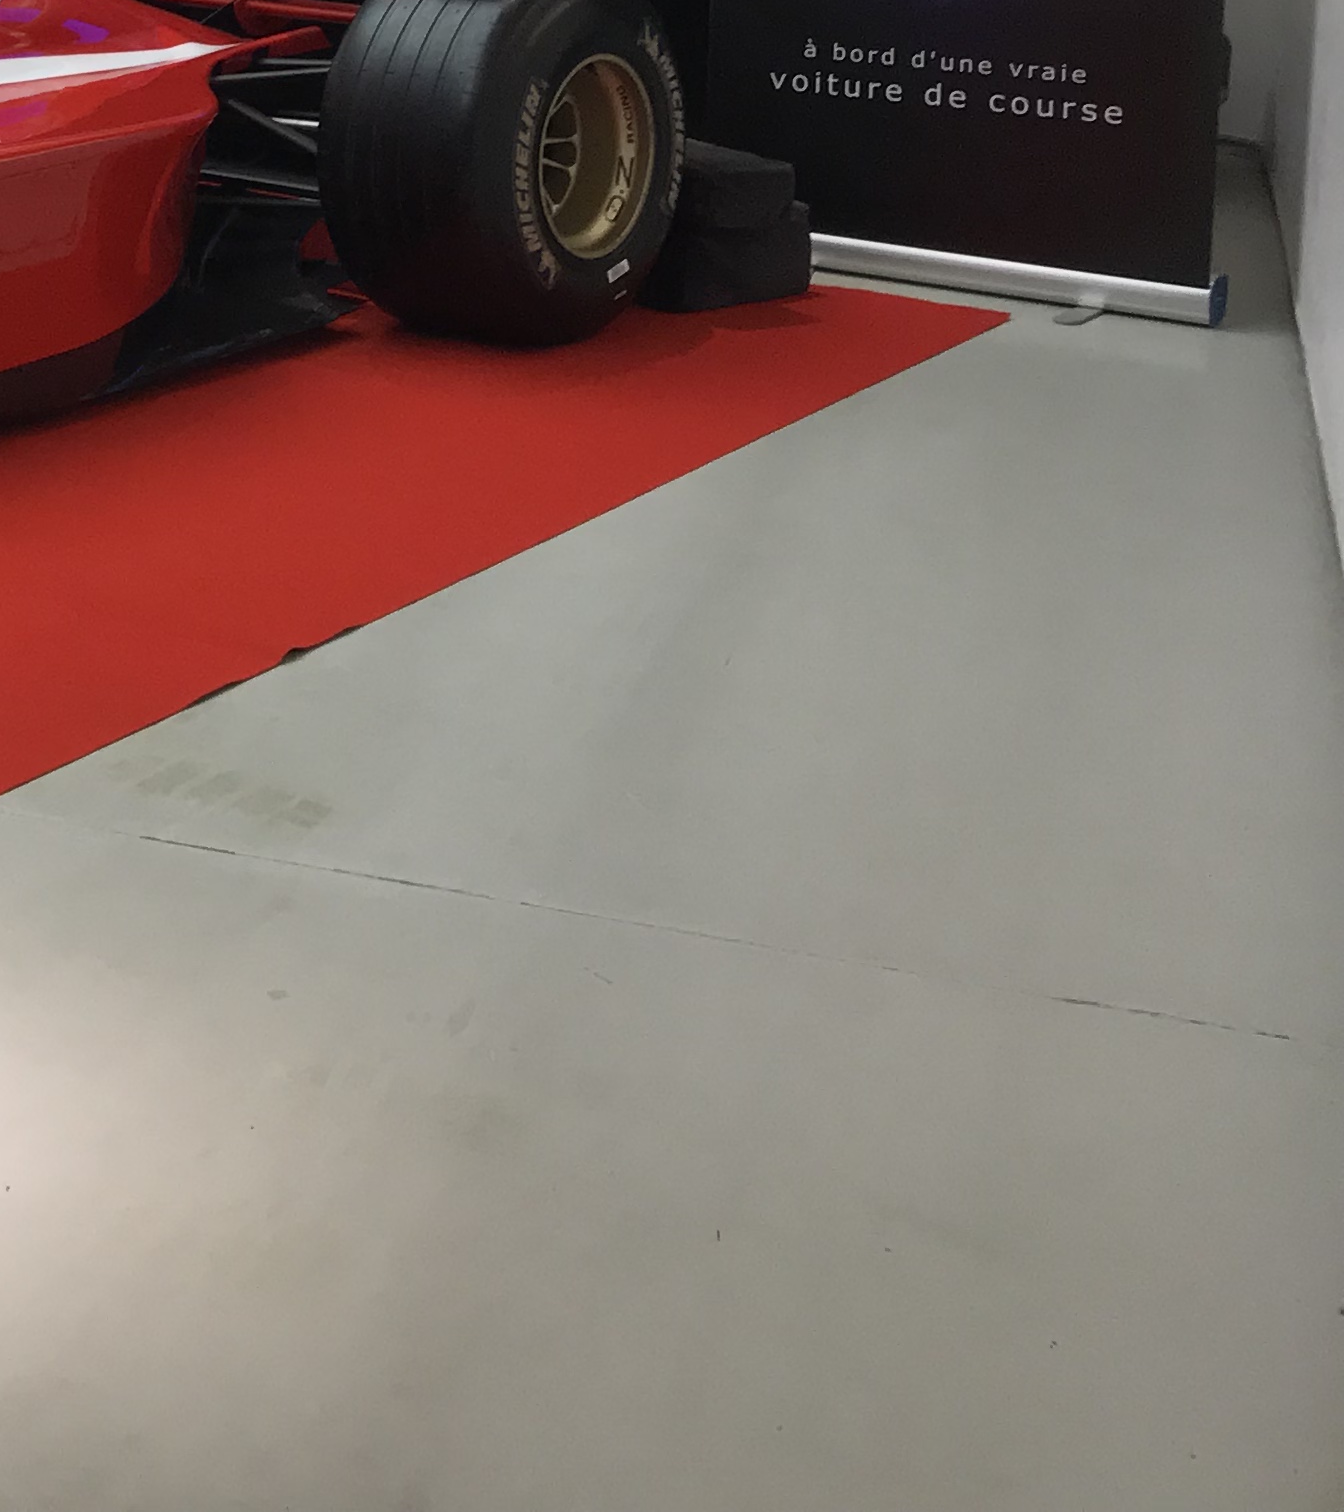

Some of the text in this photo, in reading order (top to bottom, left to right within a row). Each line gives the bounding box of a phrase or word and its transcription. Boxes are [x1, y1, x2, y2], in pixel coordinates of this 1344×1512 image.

[803, 38, 1088, 85] à bord d'une vraie
[770, 70, 1126, 126] voiture de course
